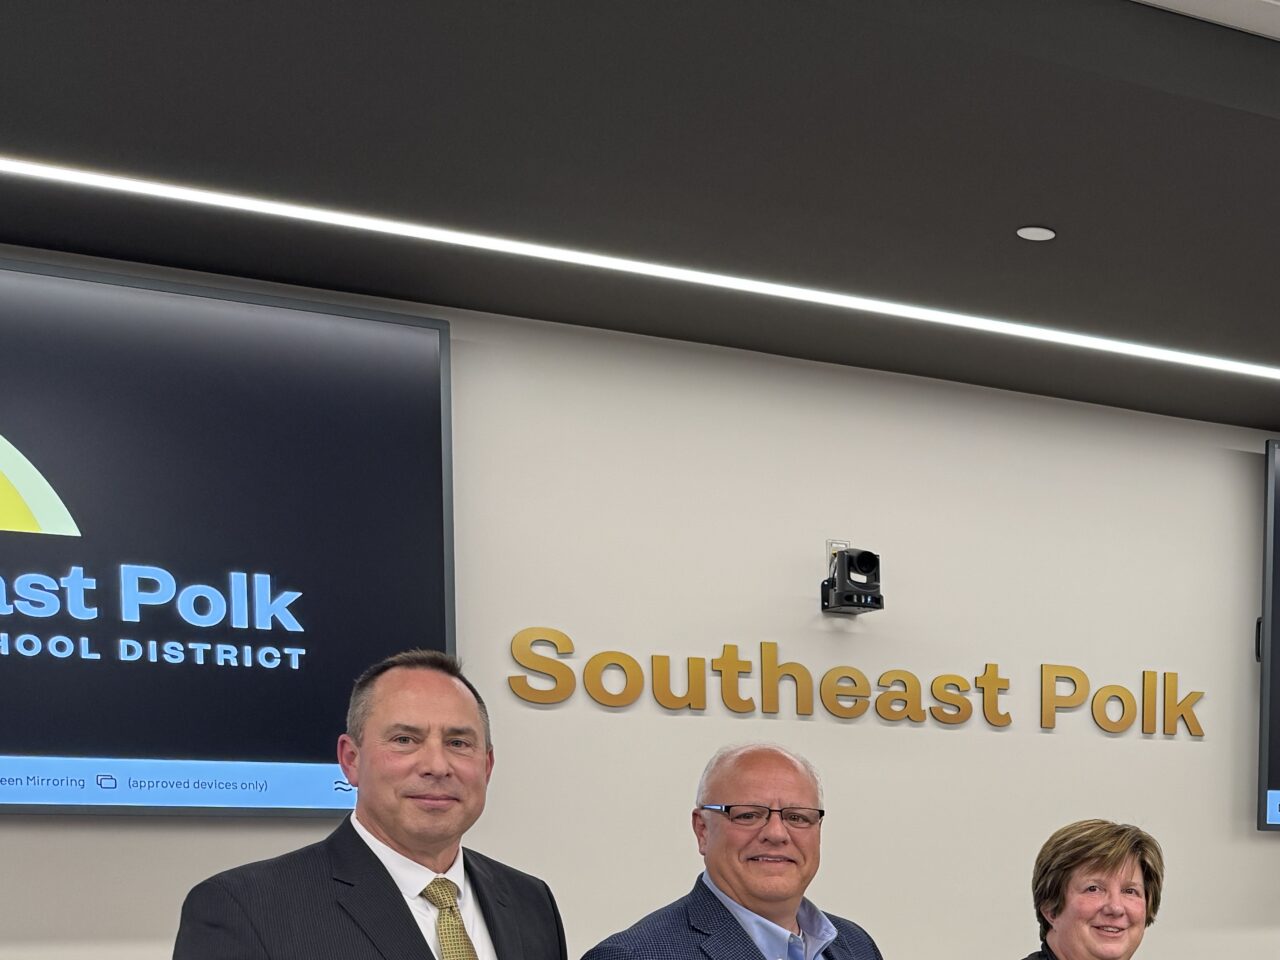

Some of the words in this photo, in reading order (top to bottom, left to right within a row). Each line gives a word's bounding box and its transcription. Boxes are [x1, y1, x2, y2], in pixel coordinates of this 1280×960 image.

[120, 564, 305, 632] Polk
[119, 638, 306, 670] DISTRICT
[508, 626, 1013, 727] Southeast
[1040, 663, 1205, 737] Polk
[26, 775, 85, 790] Mirroring
[128, 776, 190, 790] (approved
[193, 778, 238, 790] devices
[240, 779, 268, 792] only)
